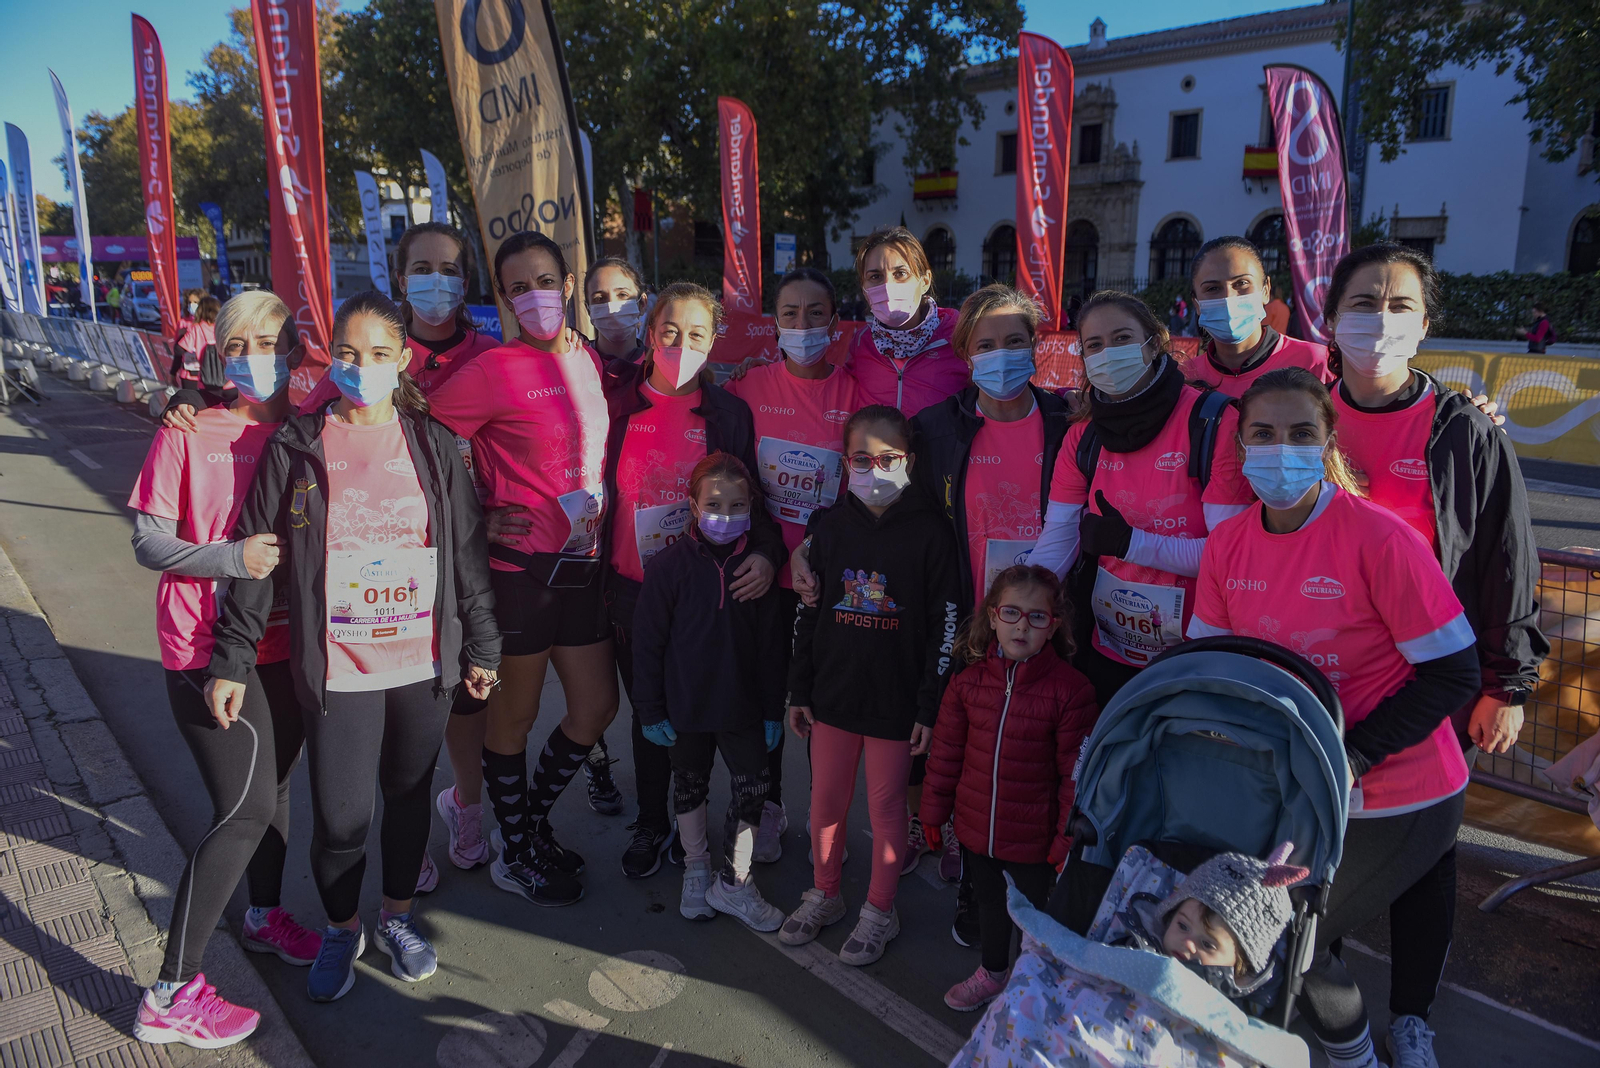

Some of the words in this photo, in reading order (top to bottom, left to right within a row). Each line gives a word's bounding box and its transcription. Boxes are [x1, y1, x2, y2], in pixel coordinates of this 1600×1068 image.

[472, 315, 501, 332] URICH
[745, 322, 775, 338] Sports
[1036, 338, 1066, 354] orts
[527, 385, 566, 400] OYSHO
[759, 404, 795, 416] OYSHO
[627, 424, 656, 434] YSHO
[206, 453, 255, 464] OYSHO
[781, 455, 817, 469] ASTURIANA
[969, 455, 1001, 465] YSHO
[1096, 459, 1124, 471] YSHO
[1393, 463, 1429, 476] ASTURIAN
[777, 472, 813, 491] 016
[659, 490, 685, 501] TOD
[783, 490, 801, 499] 1007
[801, 502, 819, 510] MUJER
[1154, 516, 1187, 529] POR
[1017, 526, 1042, 537] TOD
[364, 586, 407, 604] 016
[1303, 584, 1342, 595] ASTURIANA
[1113, 593, 1150, 610] ASTURIANA
[374, 607, 395, 616] 1011
[399, 613, 417, 622] MUJER
[835, 611, 899, 630] IMPOSTOR
[1115, 611, 1152, 635] 016
[939, 601, 957, 655] AMONG
[1124, 631, 1142, 643] 1012
[937, 657, 950, 676] US
